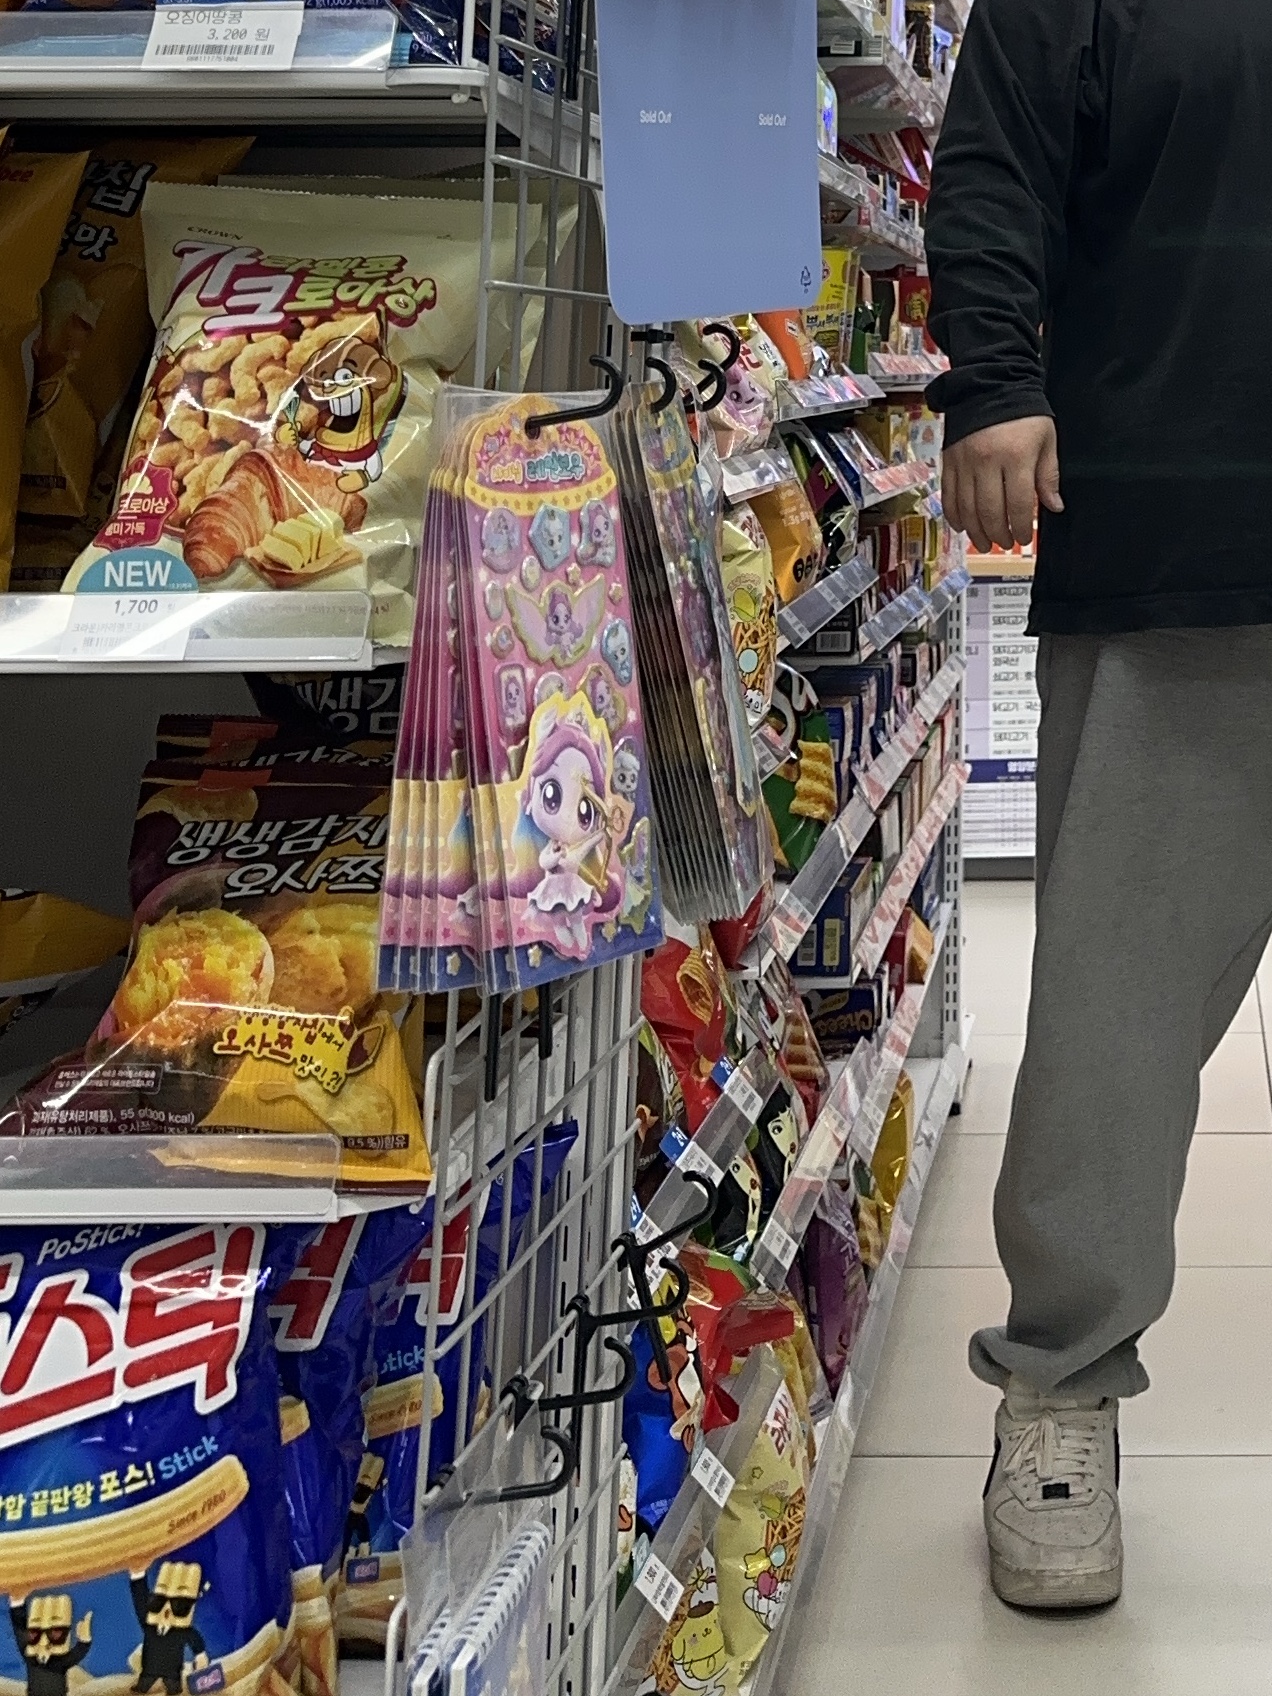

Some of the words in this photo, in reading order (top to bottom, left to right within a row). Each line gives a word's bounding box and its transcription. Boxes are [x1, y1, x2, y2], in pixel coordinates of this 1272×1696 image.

[164, 10, 244, 25] 오징어땅콩
[640, 110, 657, 123] Sold
[658, 110, 673, 123] Out
[758, 113, 774, 126] Sold
[774, 114, 787, 127] Out
[104, 560, 172, 588] NEW
[113, 599, 159, 616] 1,700
[29, 1486, 94, 1519] 끝판왕
[98, 1461, 157, 1501] 포스!
[158, 1434, 219, 1481] Stick
